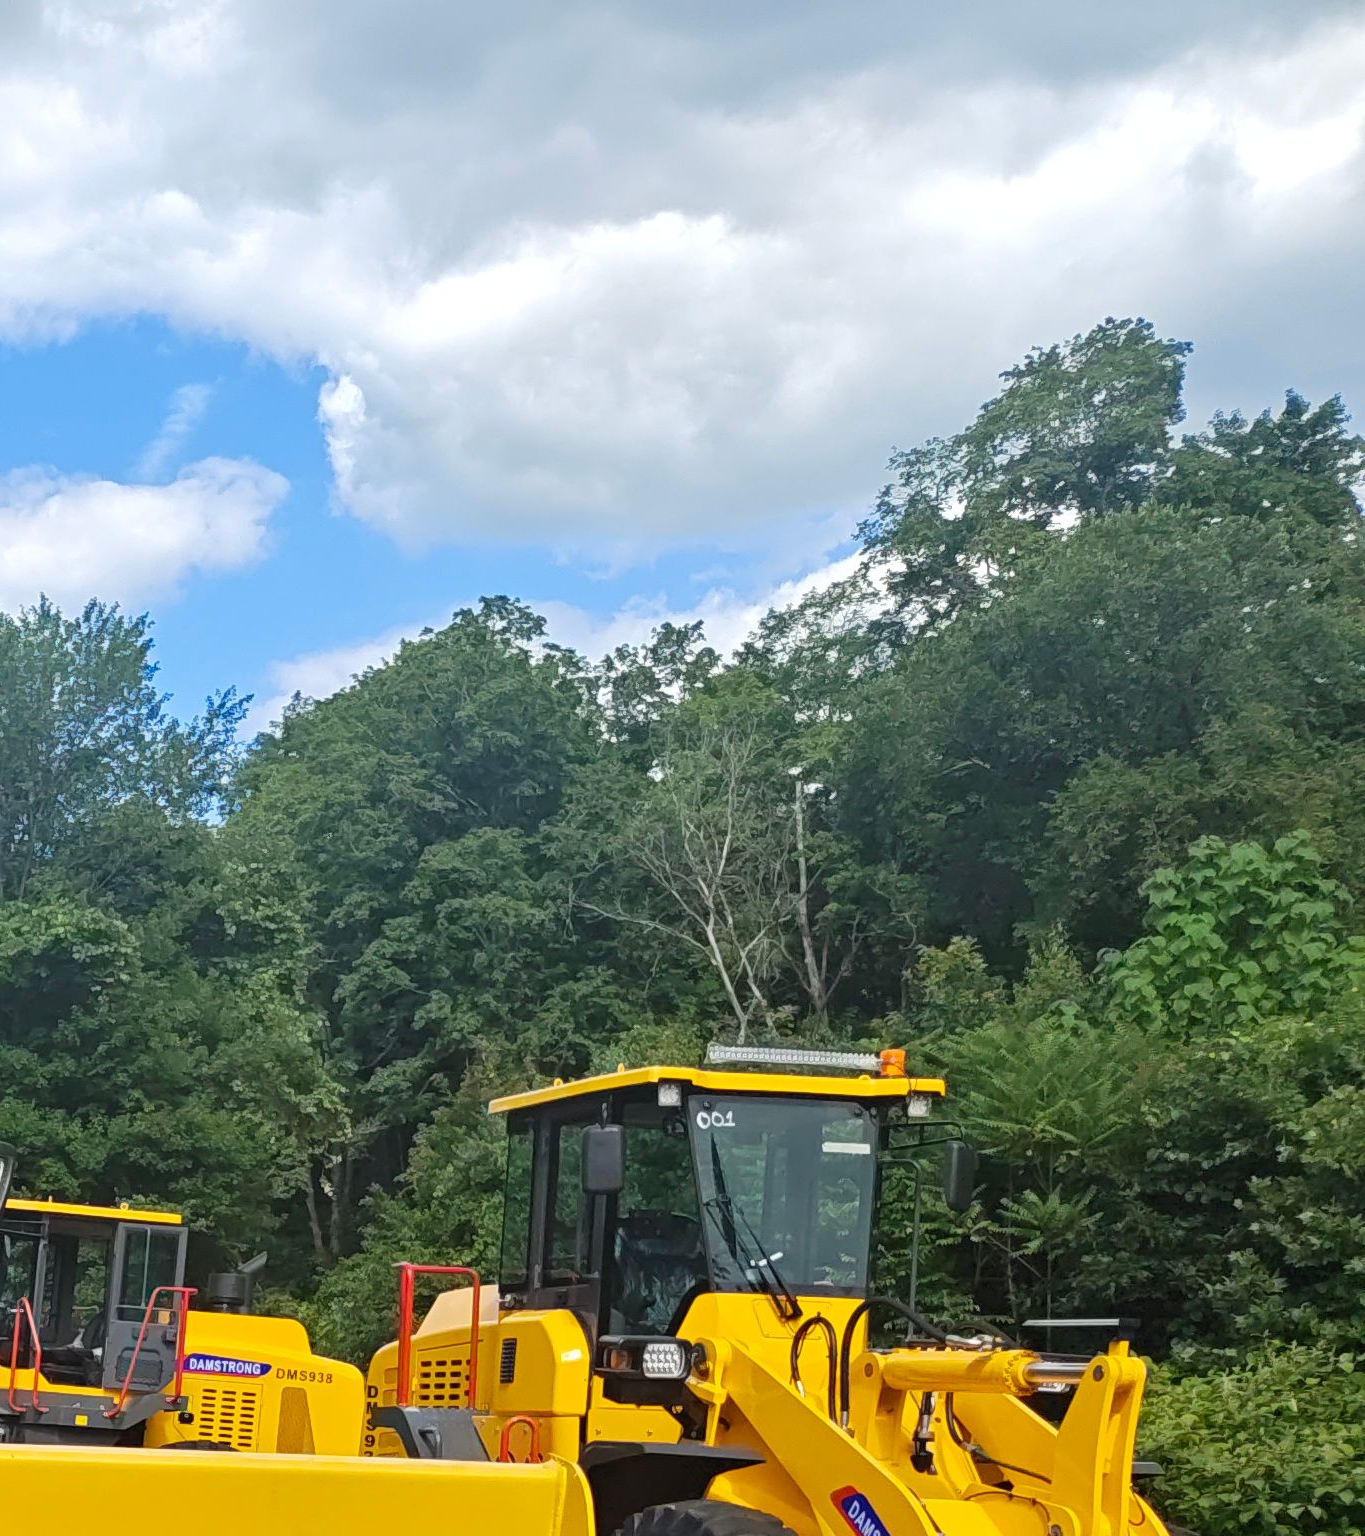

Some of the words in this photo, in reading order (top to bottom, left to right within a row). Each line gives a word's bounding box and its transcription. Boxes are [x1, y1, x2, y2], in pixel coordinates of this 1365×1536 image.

[696, 1110, 736, 1129] 001
[188, 1357, 262, 1375] DAMSTRONG
[275, 1367, 334, 1384] DMS938
